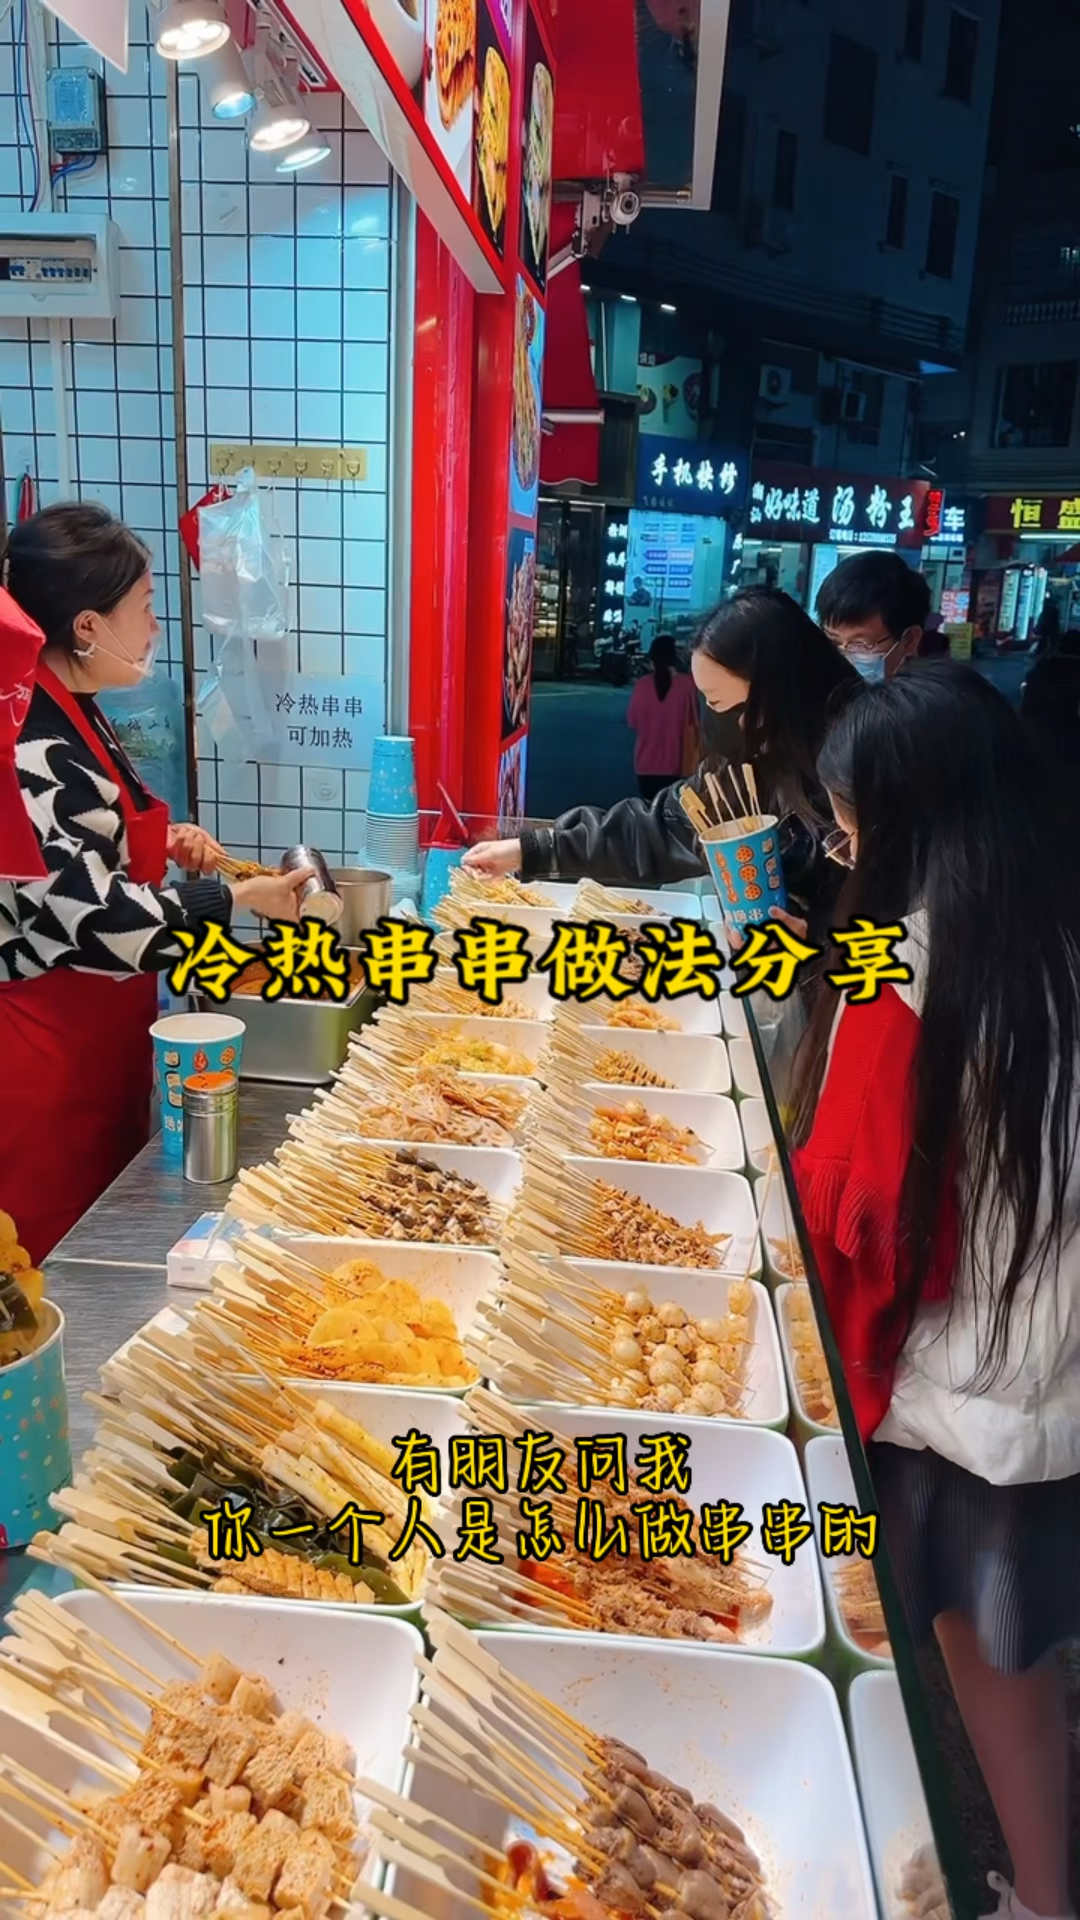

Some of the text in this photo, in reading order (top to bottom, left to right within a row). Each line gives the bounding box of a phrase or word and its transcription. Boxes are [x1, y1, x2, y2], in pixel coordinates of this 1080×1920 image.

[764, 487, 820, 523] 好味道
[831, 484, 916, 530] 汤粉王
[274, 692, 363, 718] 冷热串串
[285, 725, 354, 749] 可加热
